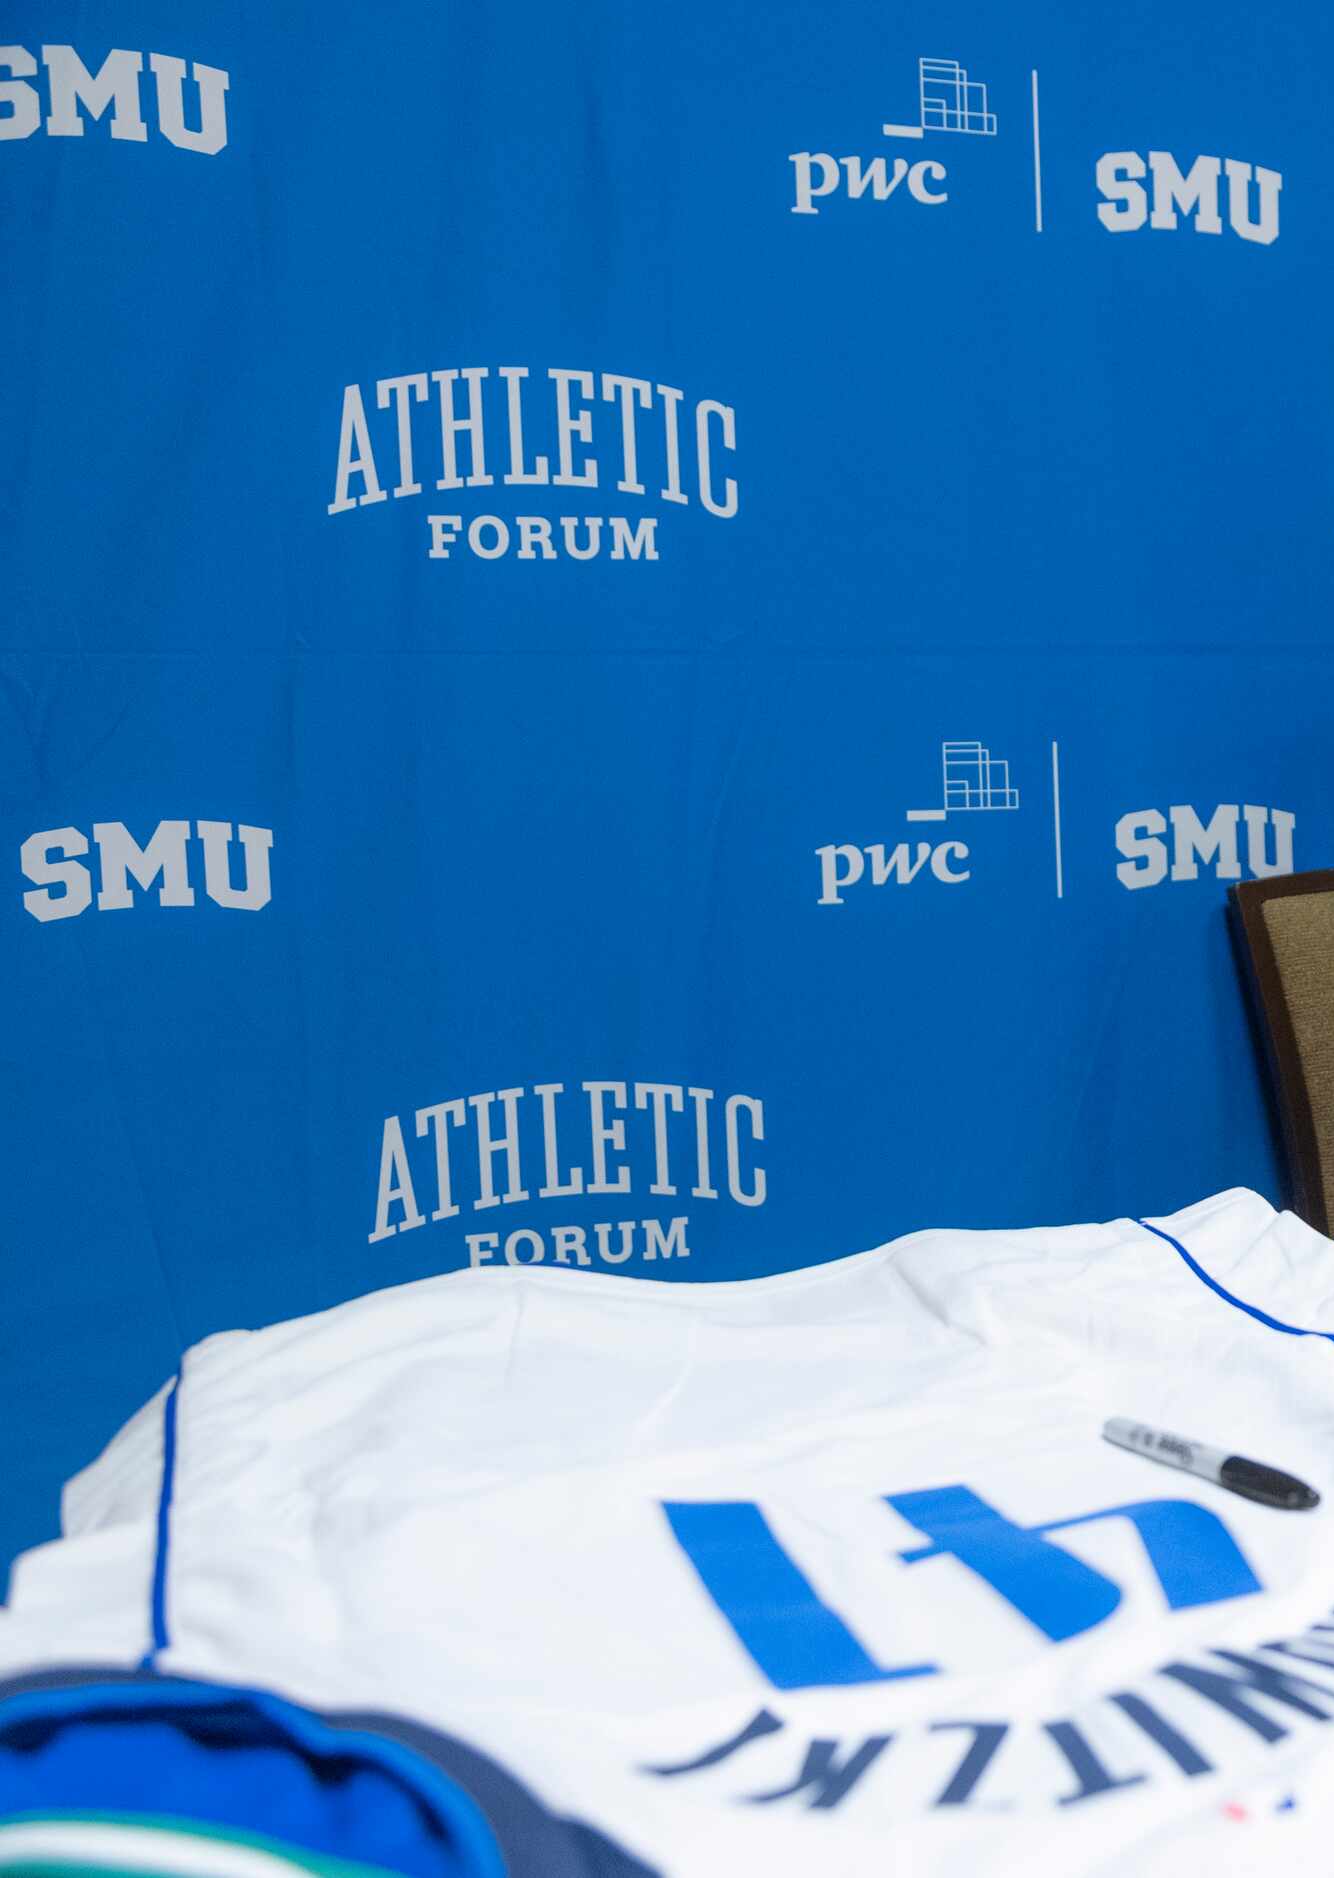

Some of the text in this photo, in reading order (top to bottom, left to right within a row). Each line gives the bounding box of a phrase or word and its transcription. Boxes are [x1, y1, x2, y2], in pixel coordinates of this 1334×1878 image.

[788, 151, 1282, 245] pwc SMU
[328, 366, 738, 519] ATHLETIC
[427, 515, 660, 560] FORUM
[20, 820, 273, 923] SMU
[815, 804, 1296, 905] pwc SMU
[368, 1081, 767, 1244] ATHLETIC
[465, 1217, 691, 1267] FORUM
[658, 1483, 1264, 1691] 41
